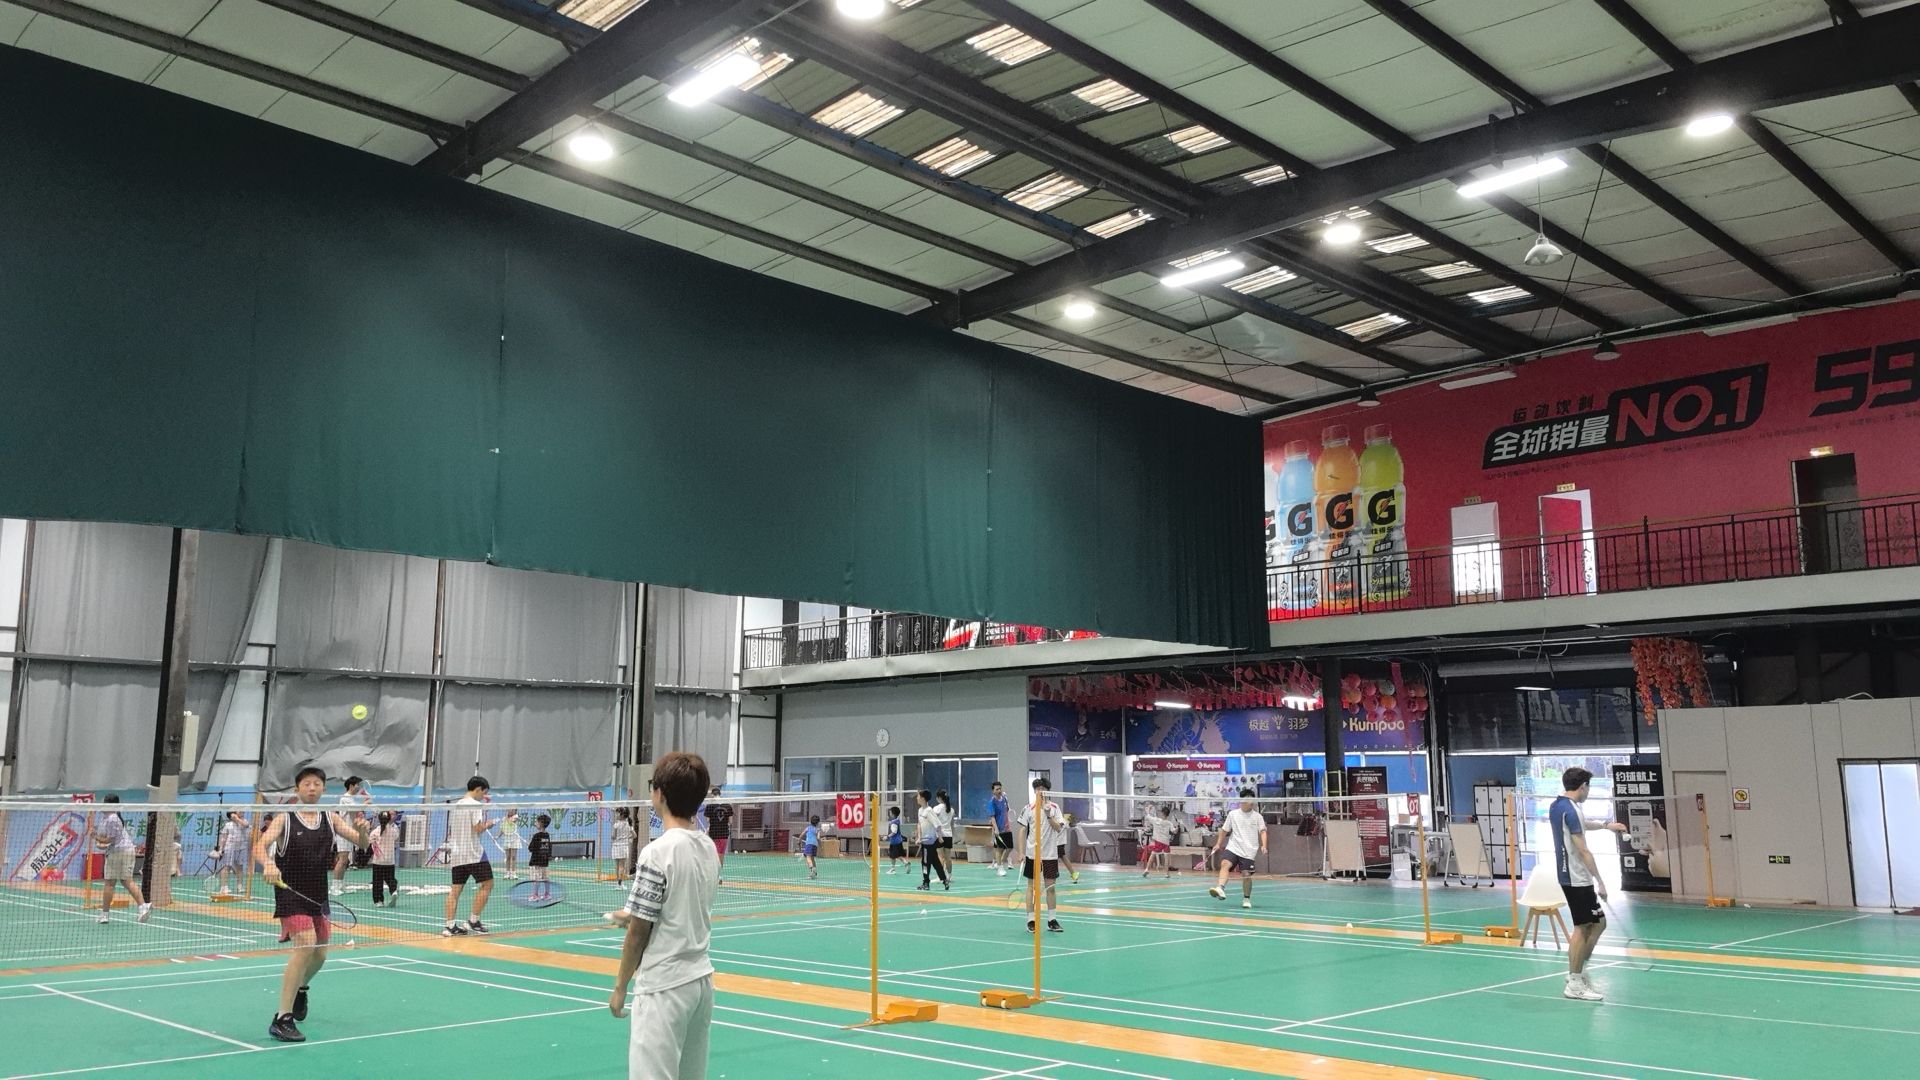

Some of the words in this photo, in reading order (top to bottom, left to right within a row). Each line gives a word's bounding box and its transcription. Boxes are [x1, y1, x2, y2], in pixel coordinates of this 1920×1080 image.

[1615, 375, 1752, 442] NO.1
[1491, 414, 1610, 462] 全球销量
[1288, 502, 1312, 536] G
[1326, 492, 1353, 529] G
[1368, 489, 1396, 525] G
[1288, 718, 1310, 731] 羽梦
[842, 803, 863, 824] 06
